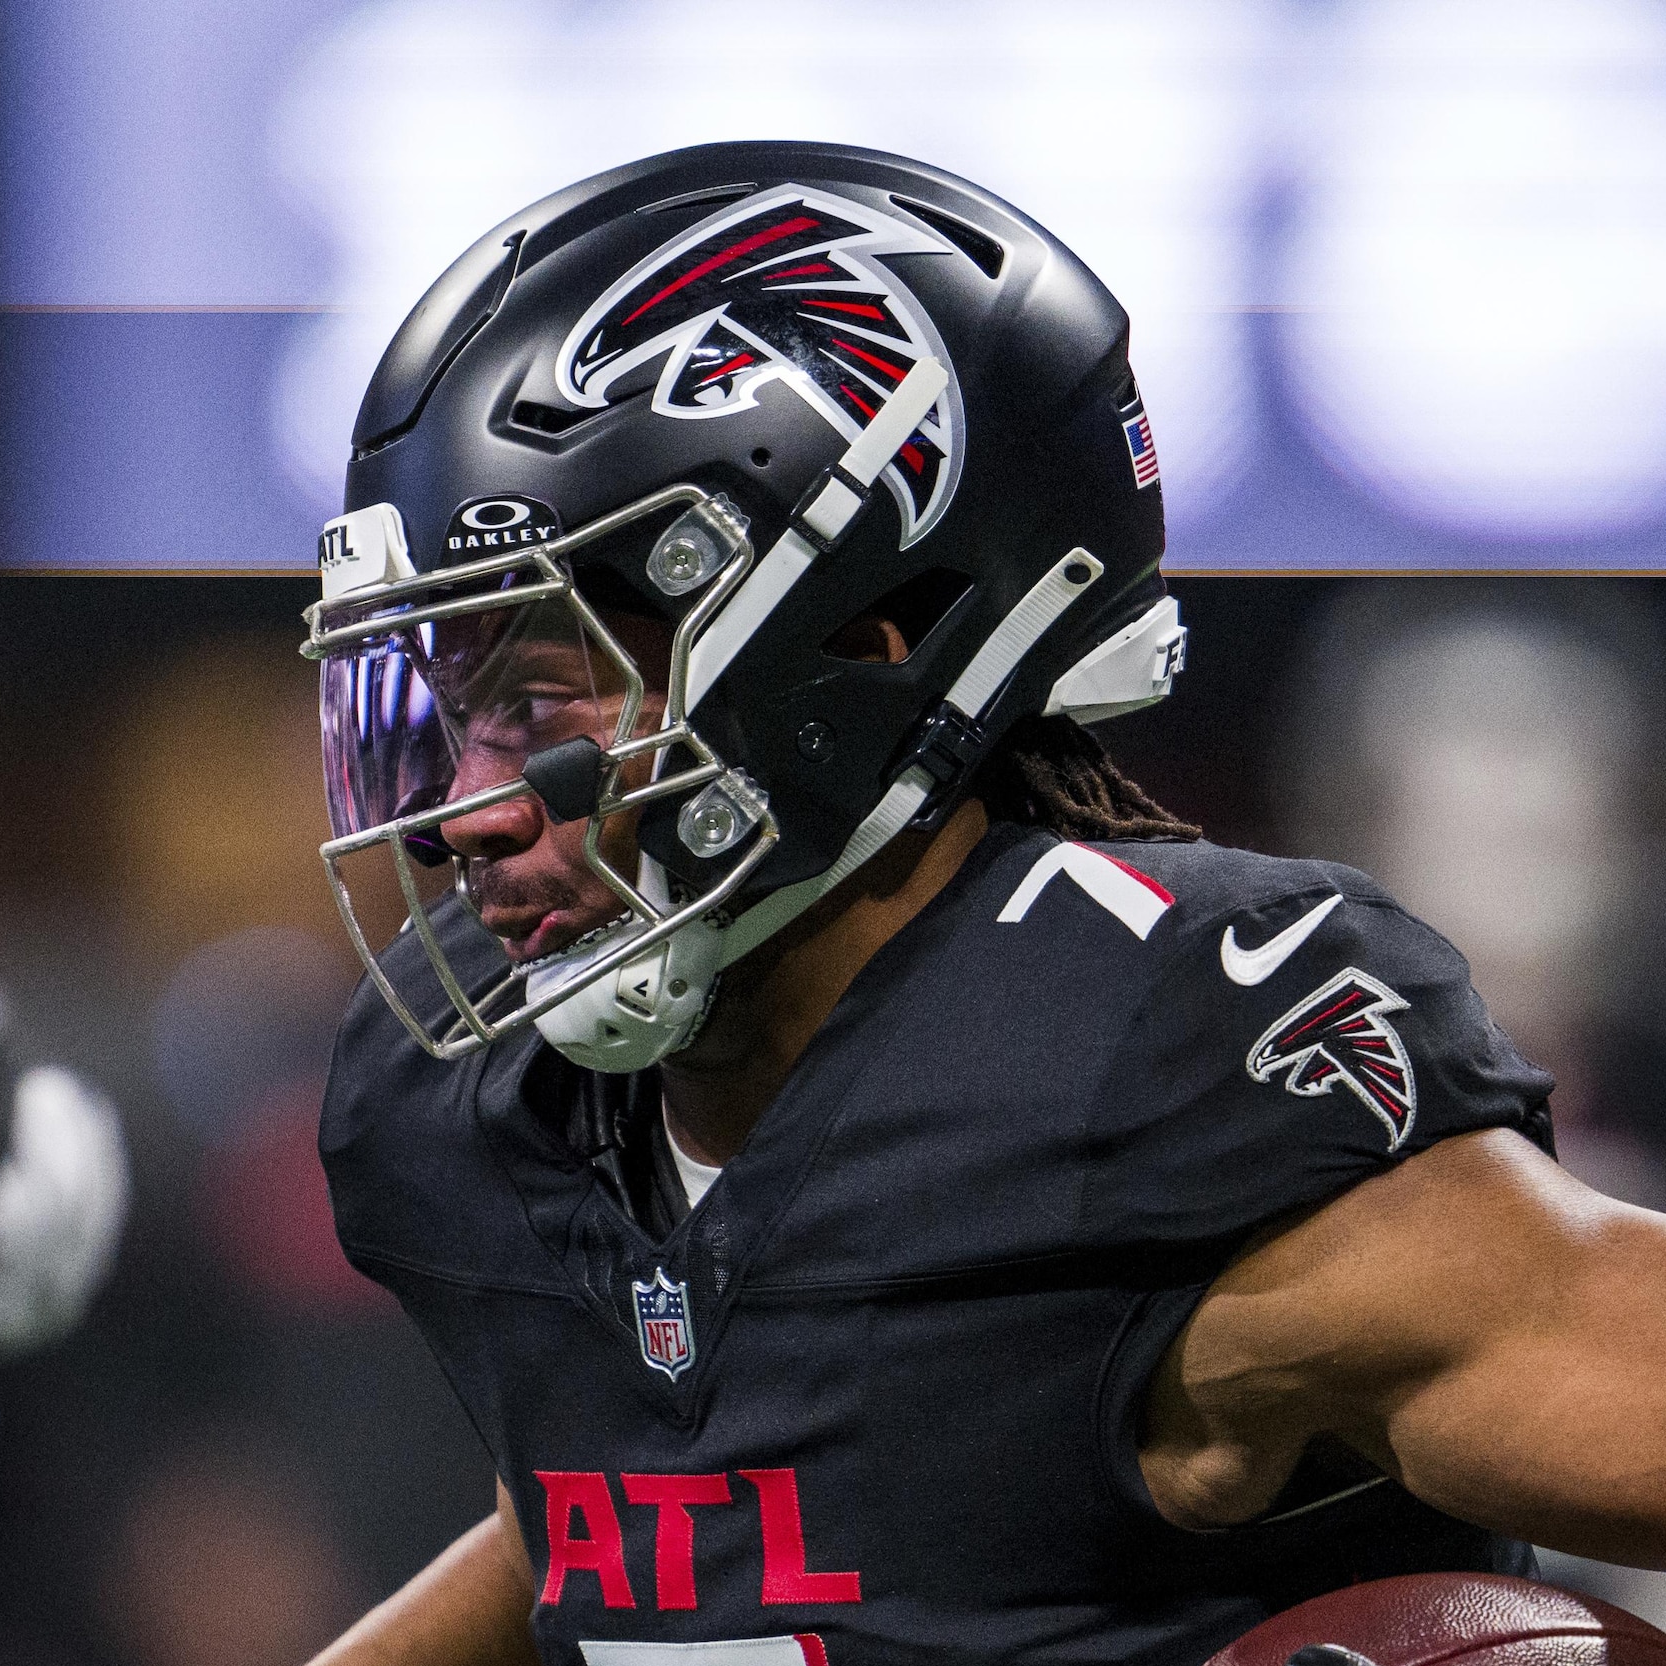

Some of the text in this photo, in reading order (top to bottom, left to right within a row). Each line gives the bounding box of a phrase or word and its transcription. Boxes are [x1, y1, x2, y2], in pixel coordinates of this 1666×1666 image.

[448, 525, 551, 550] OAKLEY
[996, 841, 1176, 941] 7
[645, 1321, 687, 1363] NFL
[533, 1467, 862, 1611] ATL
